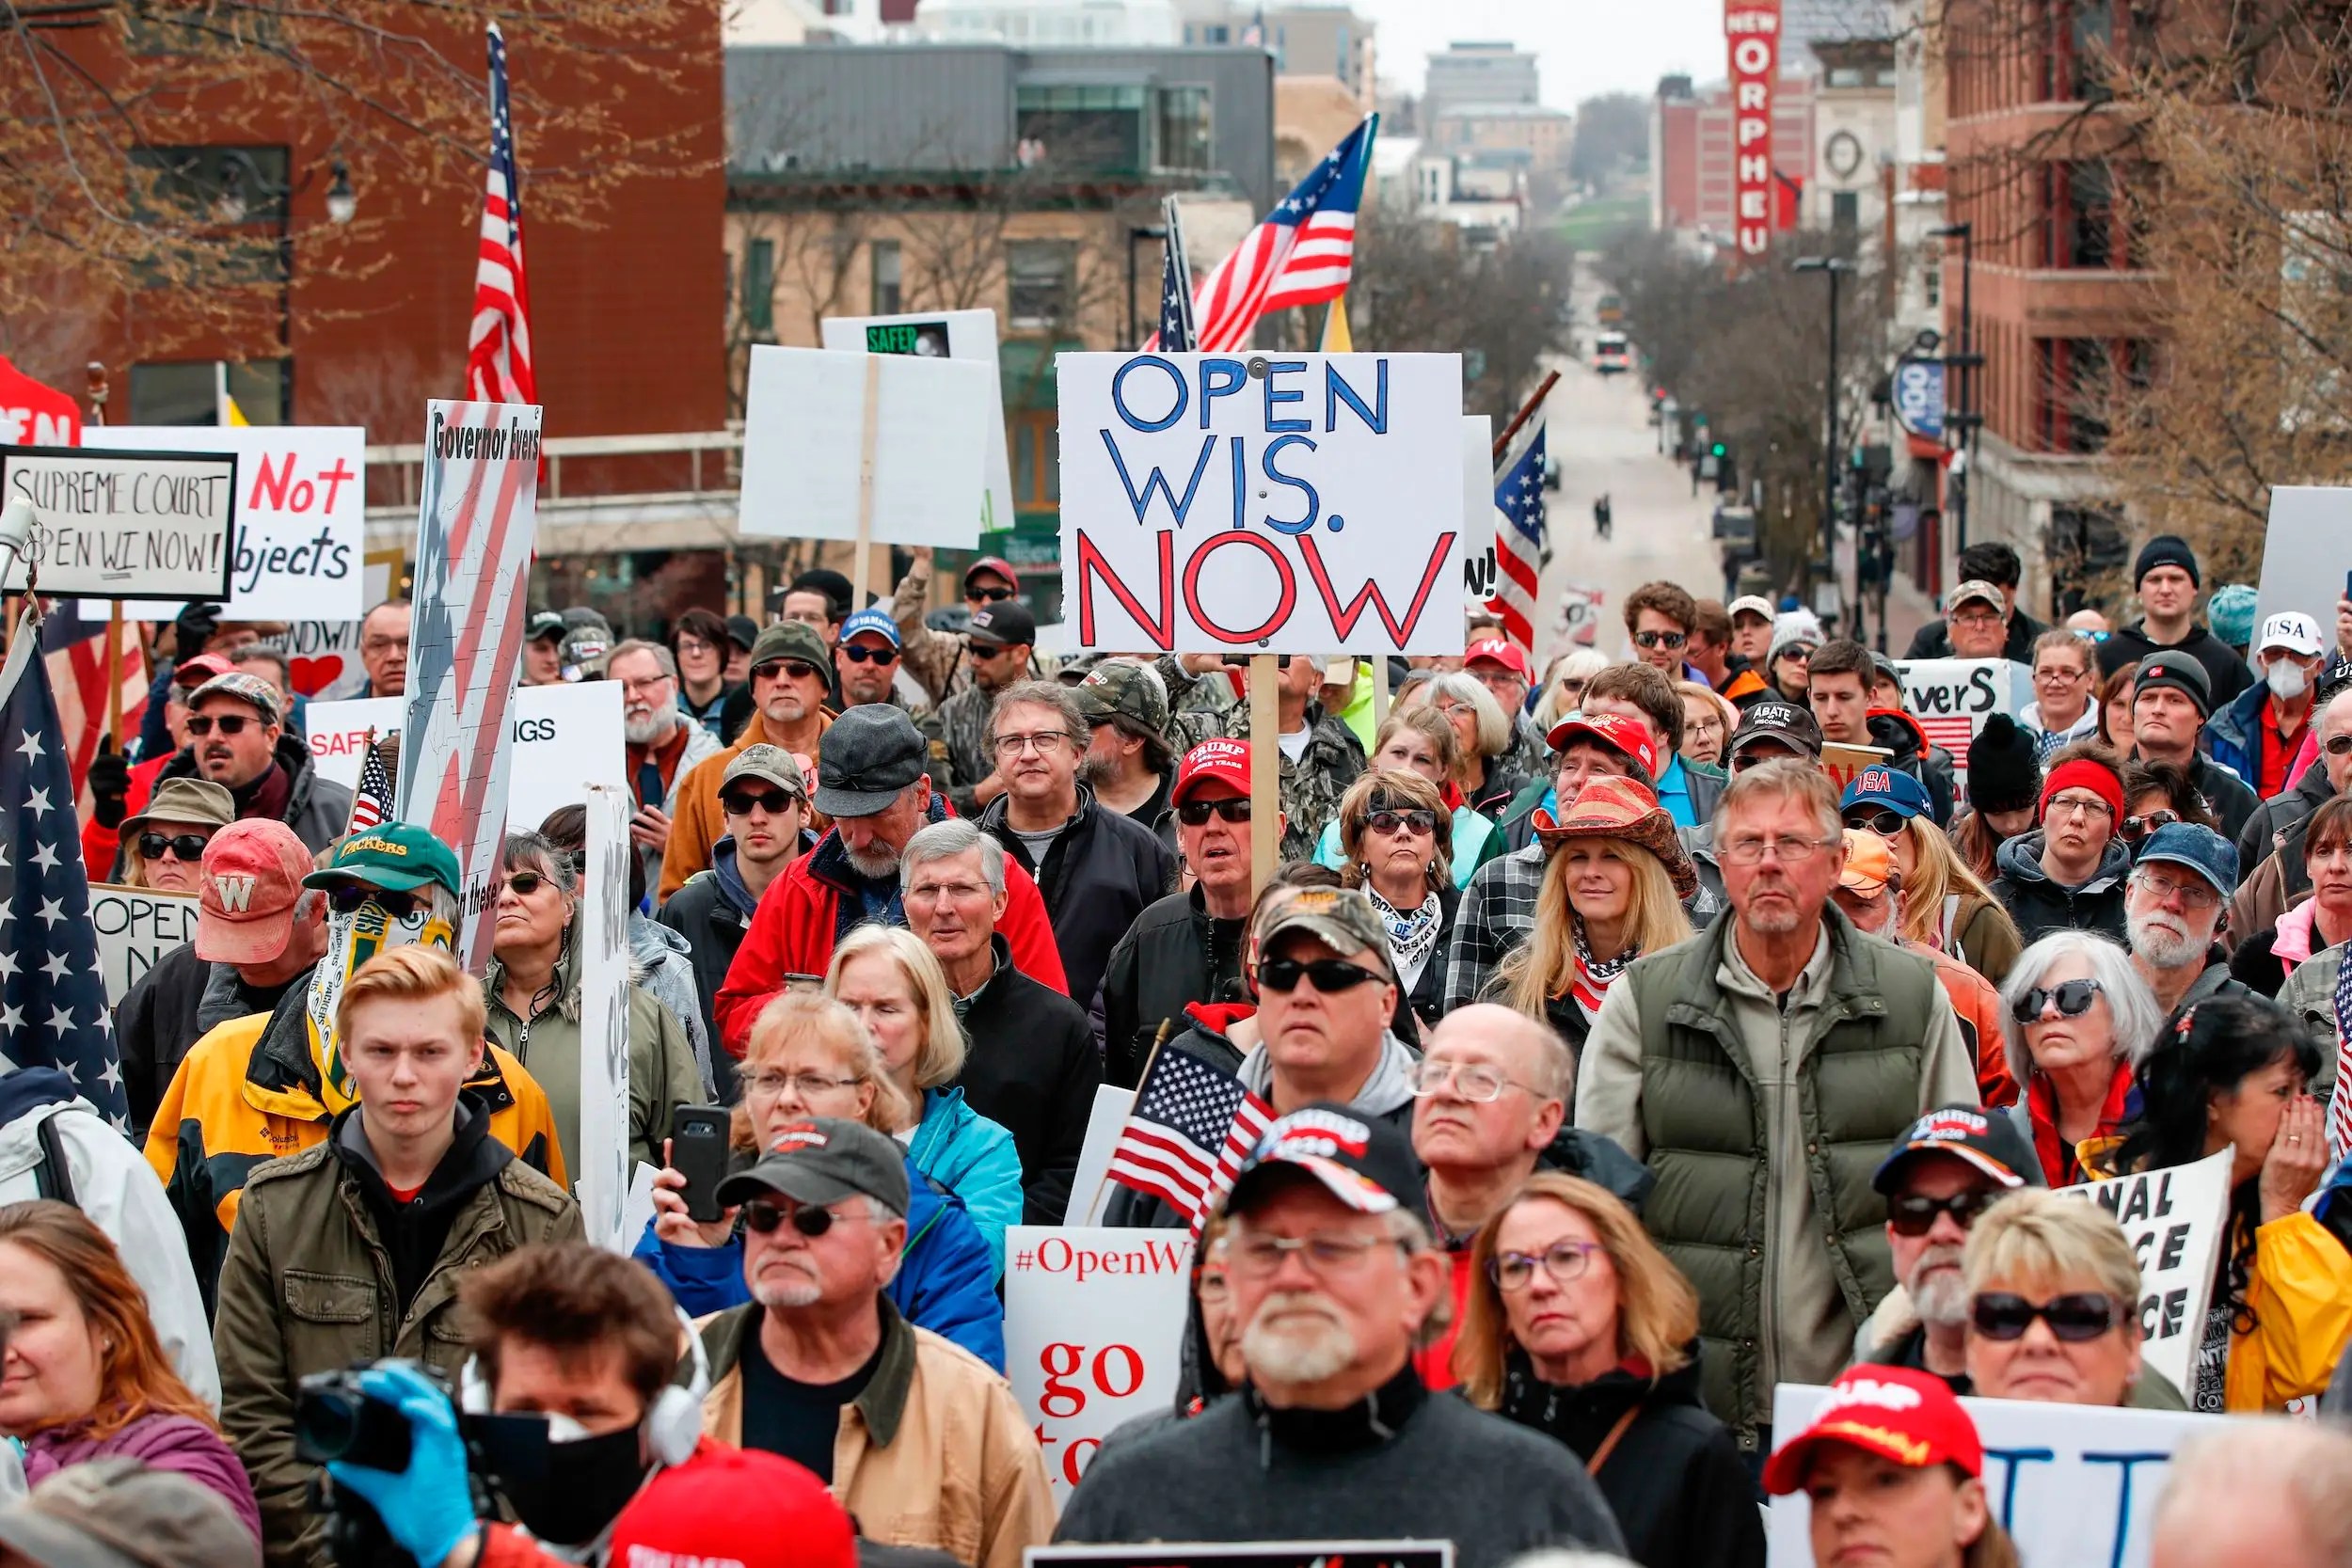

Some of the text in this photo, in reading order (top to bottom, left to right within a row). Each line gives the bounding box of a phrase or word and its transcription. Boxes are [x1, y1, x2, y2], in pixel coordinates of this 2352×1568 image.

[1725, 10, 1777, 35] NEW
[1112, 354, 1389, 435] OPEN
[434, 411, 539, 460] Governor Evers
[13, 469, 228, 518] SUPREME COURT
[248, 451, 355, 515] Not
[1099, 429, 1345, 535] WIS.
[101, 531, 139, 571] WI
[145, 529, 223, 574] NOW!
[232, 525, 352, 594] bjects
[1077, 528, 1457, 652] NOW
[858, 616, 895, 634] YAMAHA
[2266, 620, 2306, 639] USA
[1753, 705, 1791, 723] ABATE
[1755, 719, 1788, 728] WISCONSIN
[1188, 741, 1246, 765] TRUMP
[1855, 771, 1891, 797] USA
[340, 839, 408, 861] PACKERS
[215, 876, 257, 912] W
[469, 874, 498, 917] these
[317, 980, 334, 1026] PACKERS
[1015, 1237, 1198, 1282] #OpenW
[1039, 1342, 1144, 1418] go
